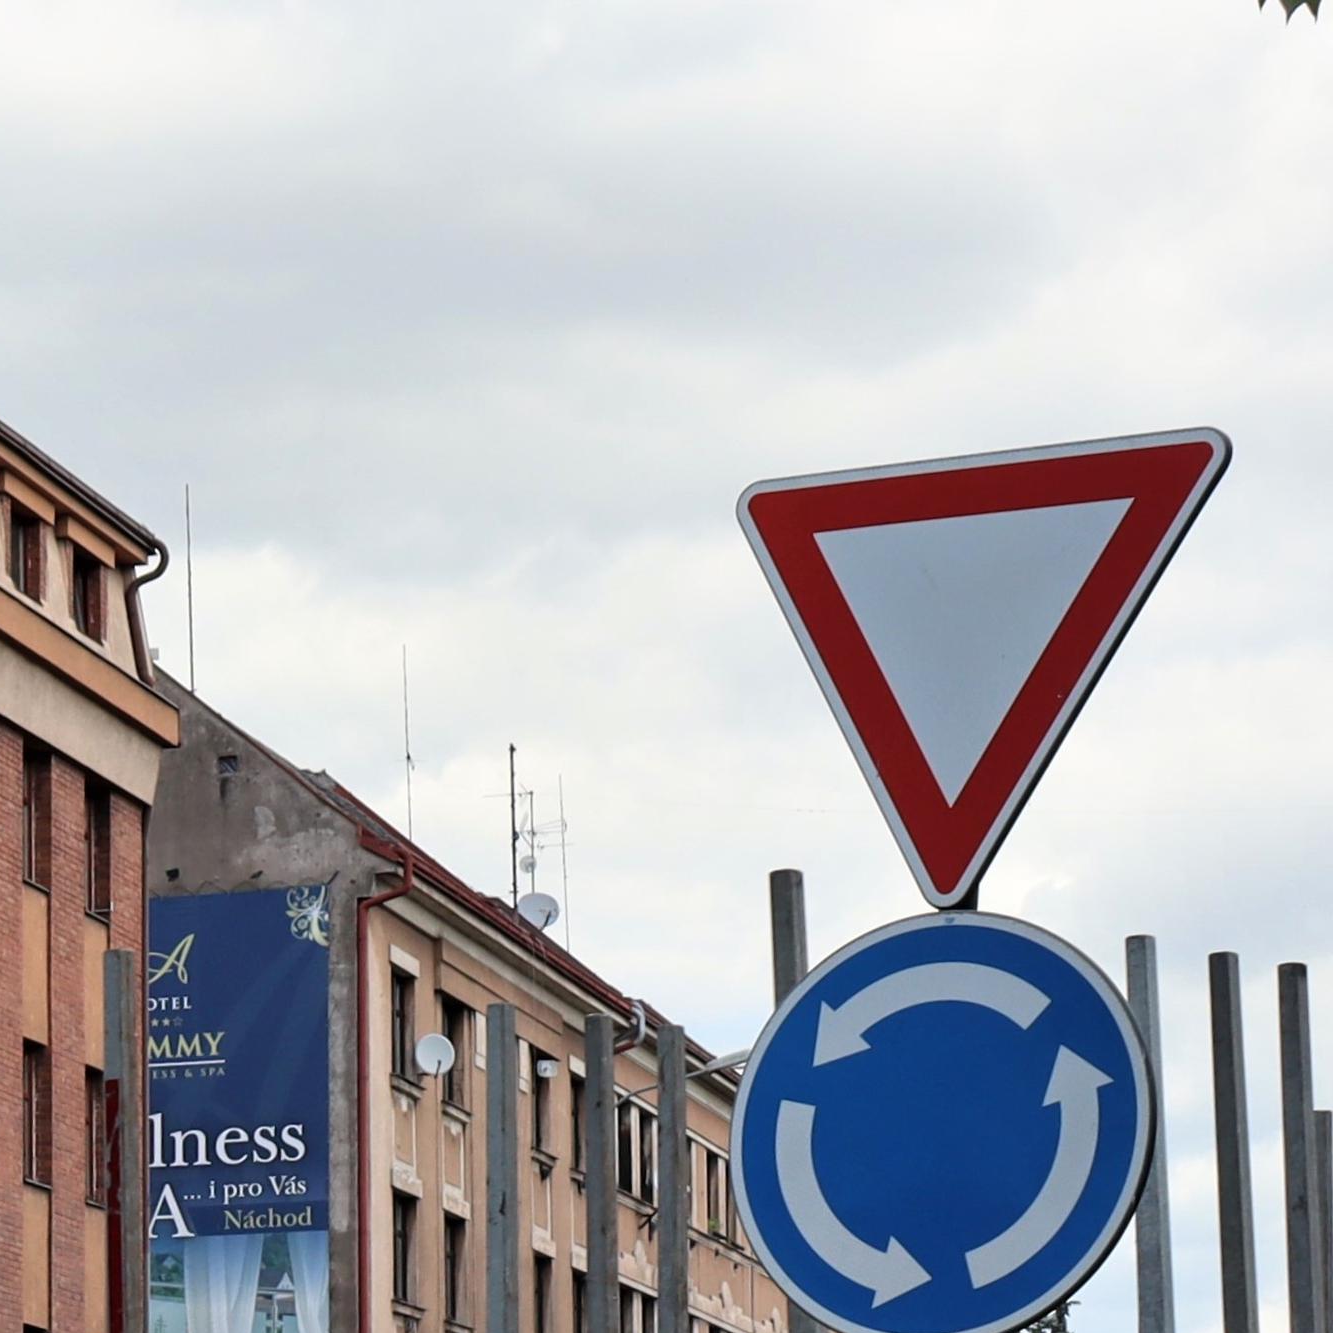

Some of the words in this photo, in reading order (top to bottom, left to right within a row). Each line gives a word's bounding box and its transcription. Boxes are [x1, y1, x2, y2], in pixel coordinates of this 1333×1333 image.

[200, 1066, 226, 1077] SPA
[223, 1182, 263, 1206] pro
[268, 1175, 307, 1196] Vás
[223, 1205, 312, 1231] Náchod
